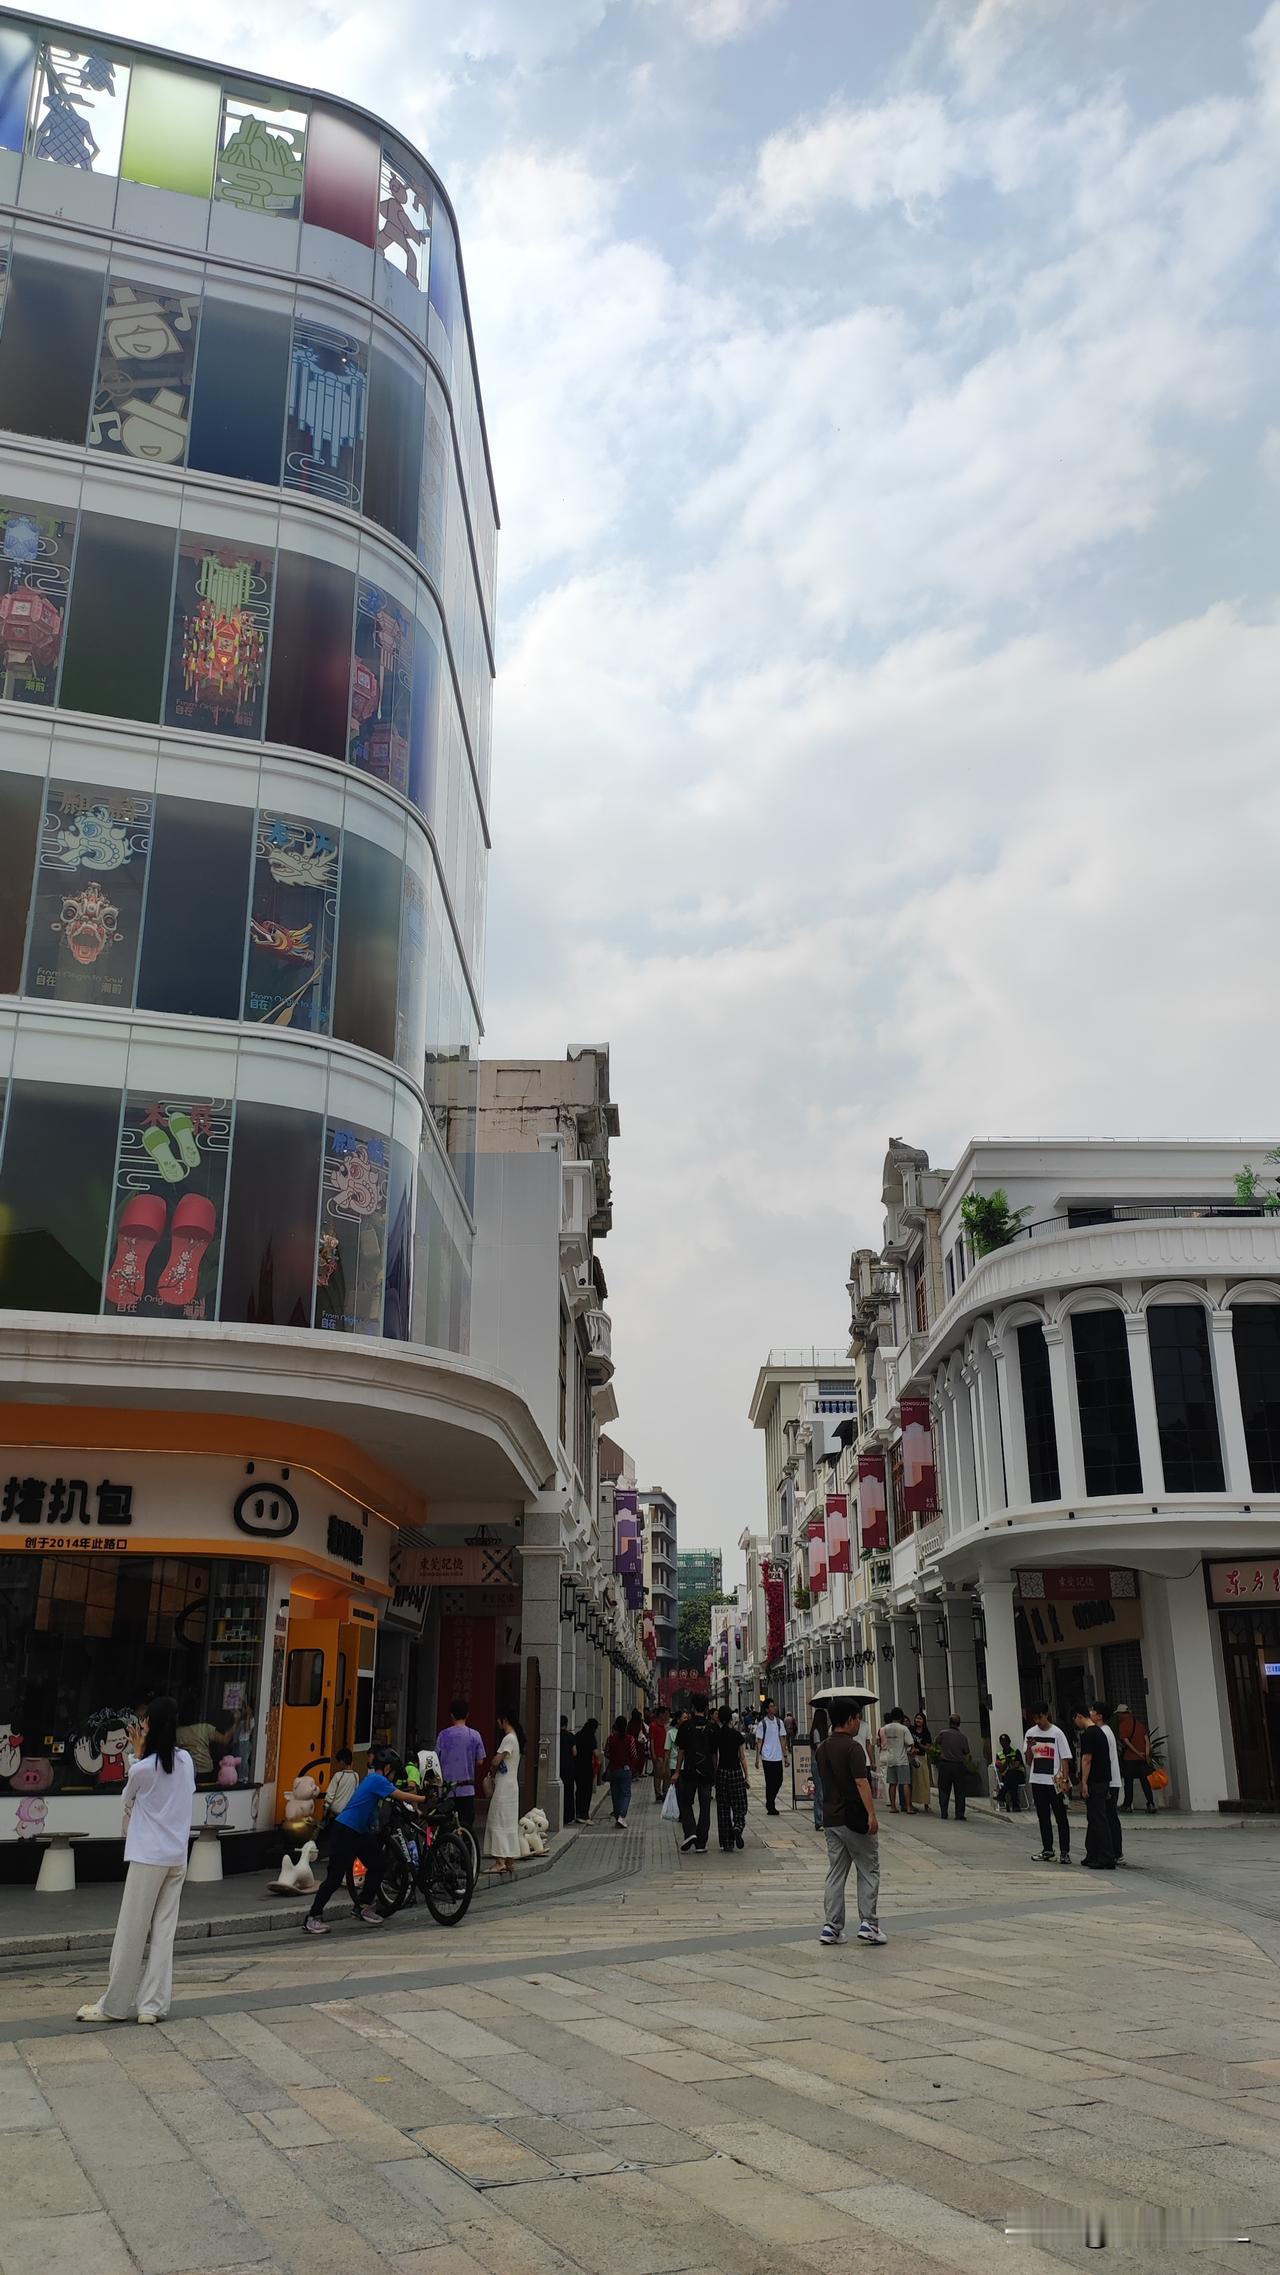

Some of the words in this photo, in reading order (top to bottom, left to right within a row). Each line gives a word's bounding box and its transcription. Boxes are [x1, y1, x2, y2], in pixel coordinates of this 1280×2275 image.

[37, 967, 61, 977] From
[36, 975, 57, 987] 自在
[250, 991, 273, 1003] From
[321, 1310, 340, 1320] From
[321, 1317, 337, 1329] 自在
[25, 1536, 128, 1550] 创于2014年此路口
